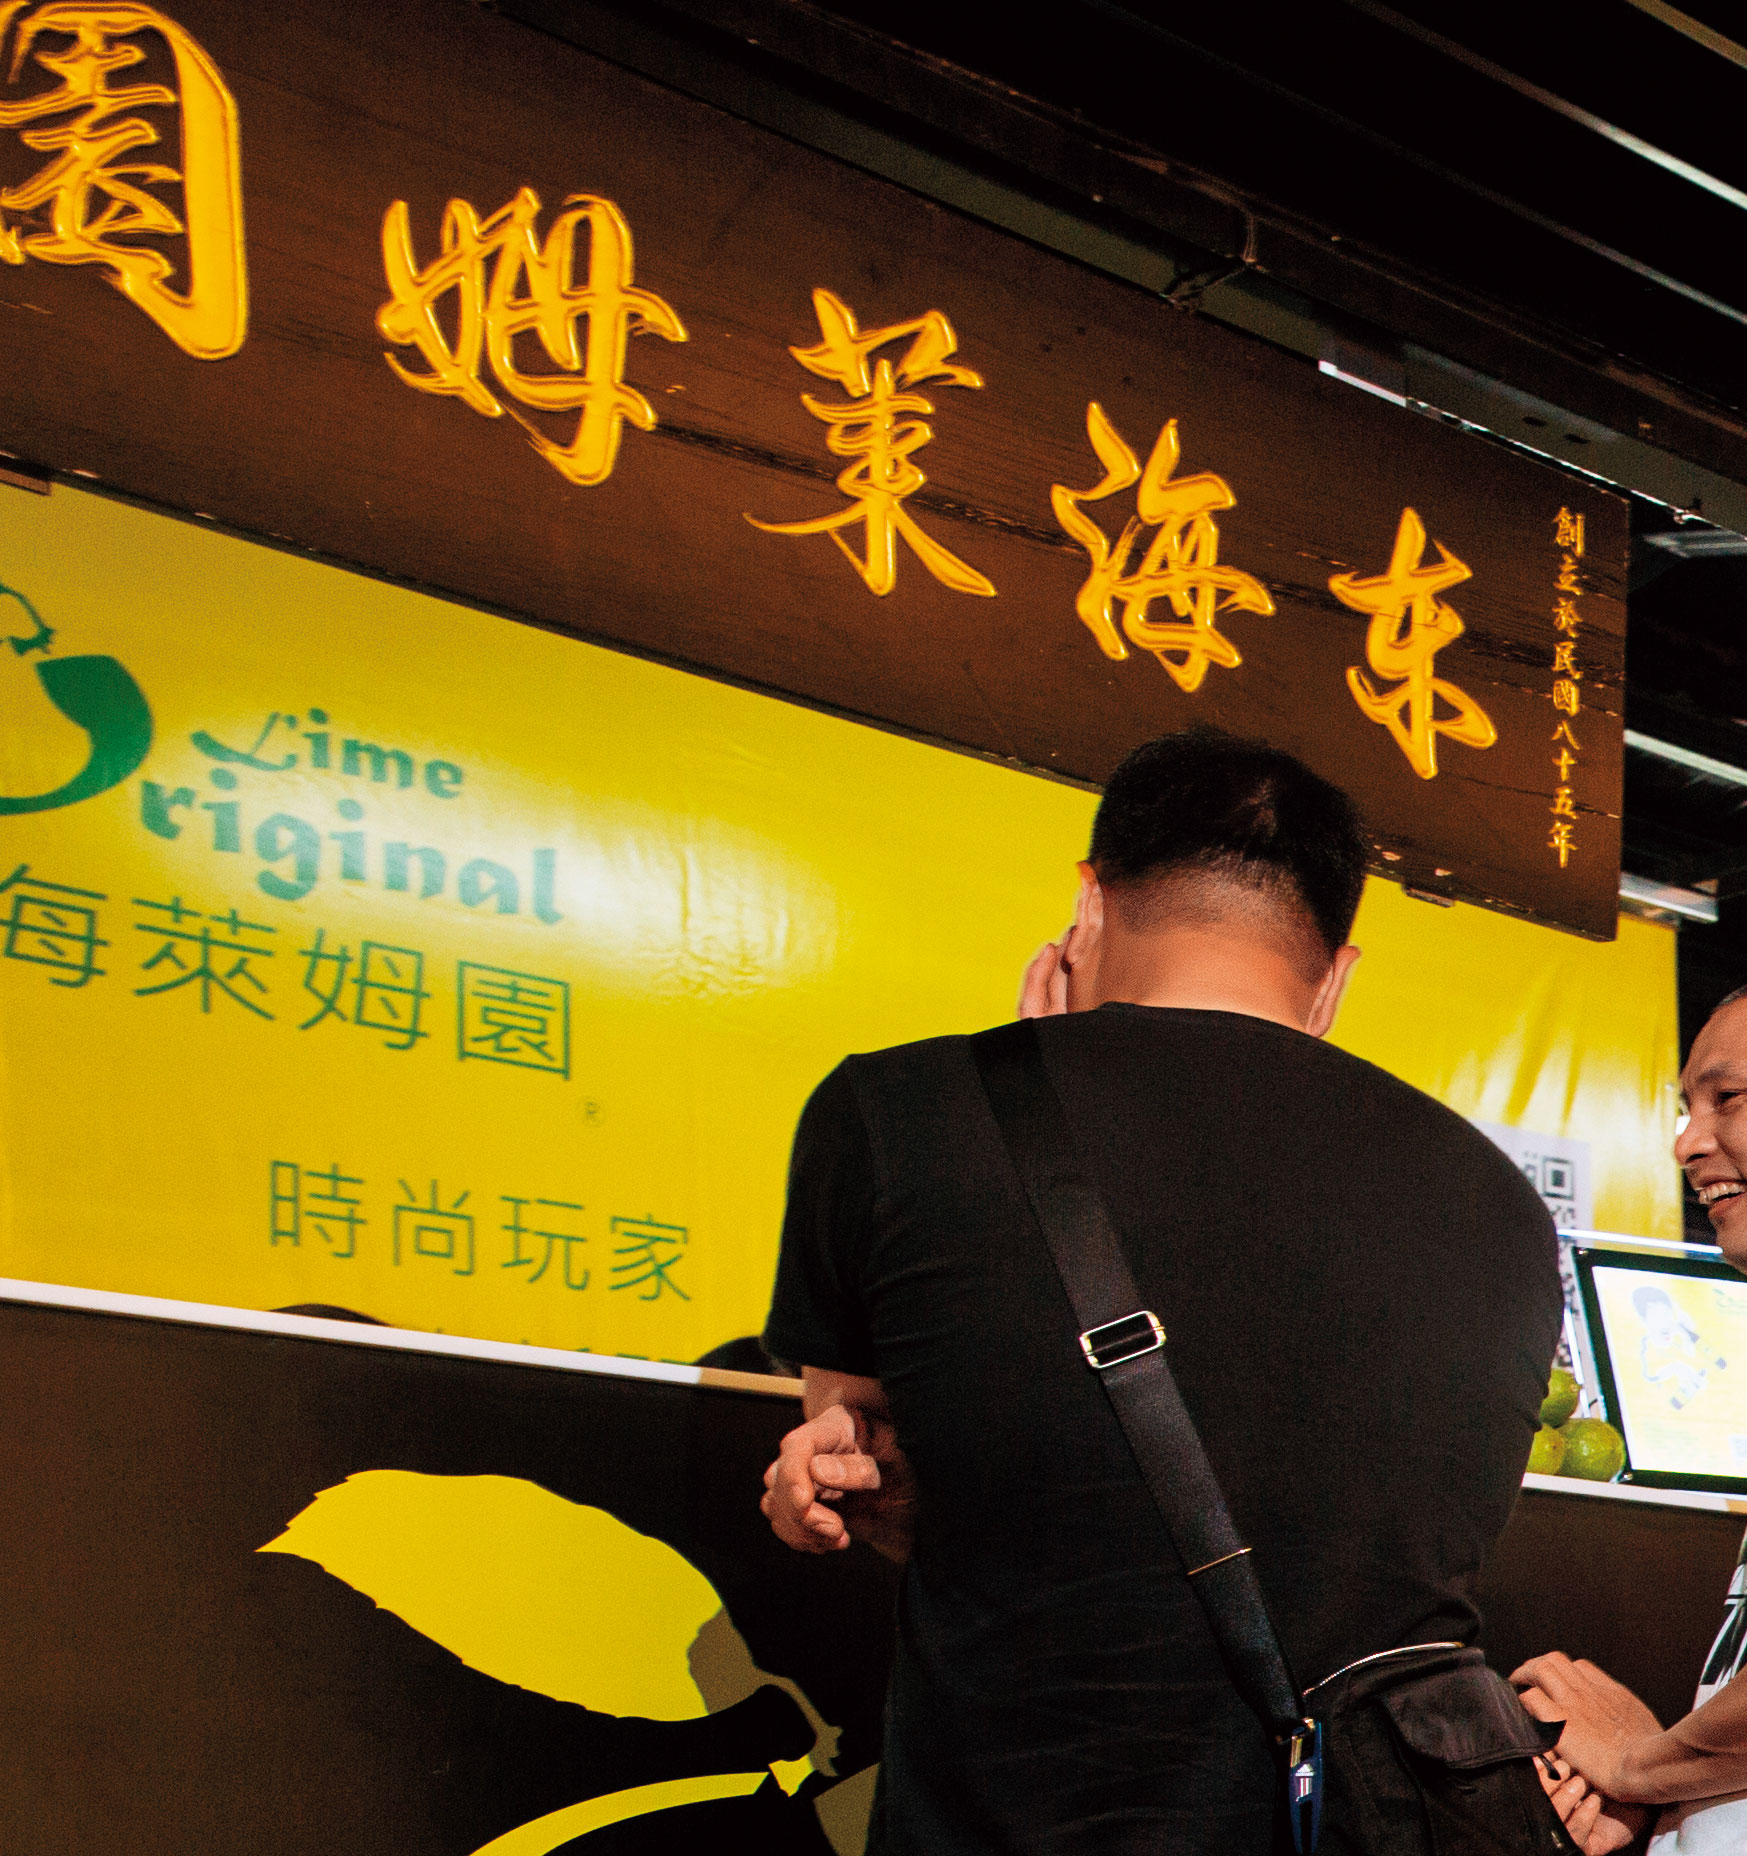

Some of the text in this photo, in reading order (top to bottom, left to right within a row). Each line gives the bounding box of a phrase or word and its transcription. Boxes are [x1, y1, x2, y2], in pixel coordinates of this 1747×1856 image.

[190, 707, 466, 799] Lime
[267, 1158, 695, 1303] 時尚玩家
